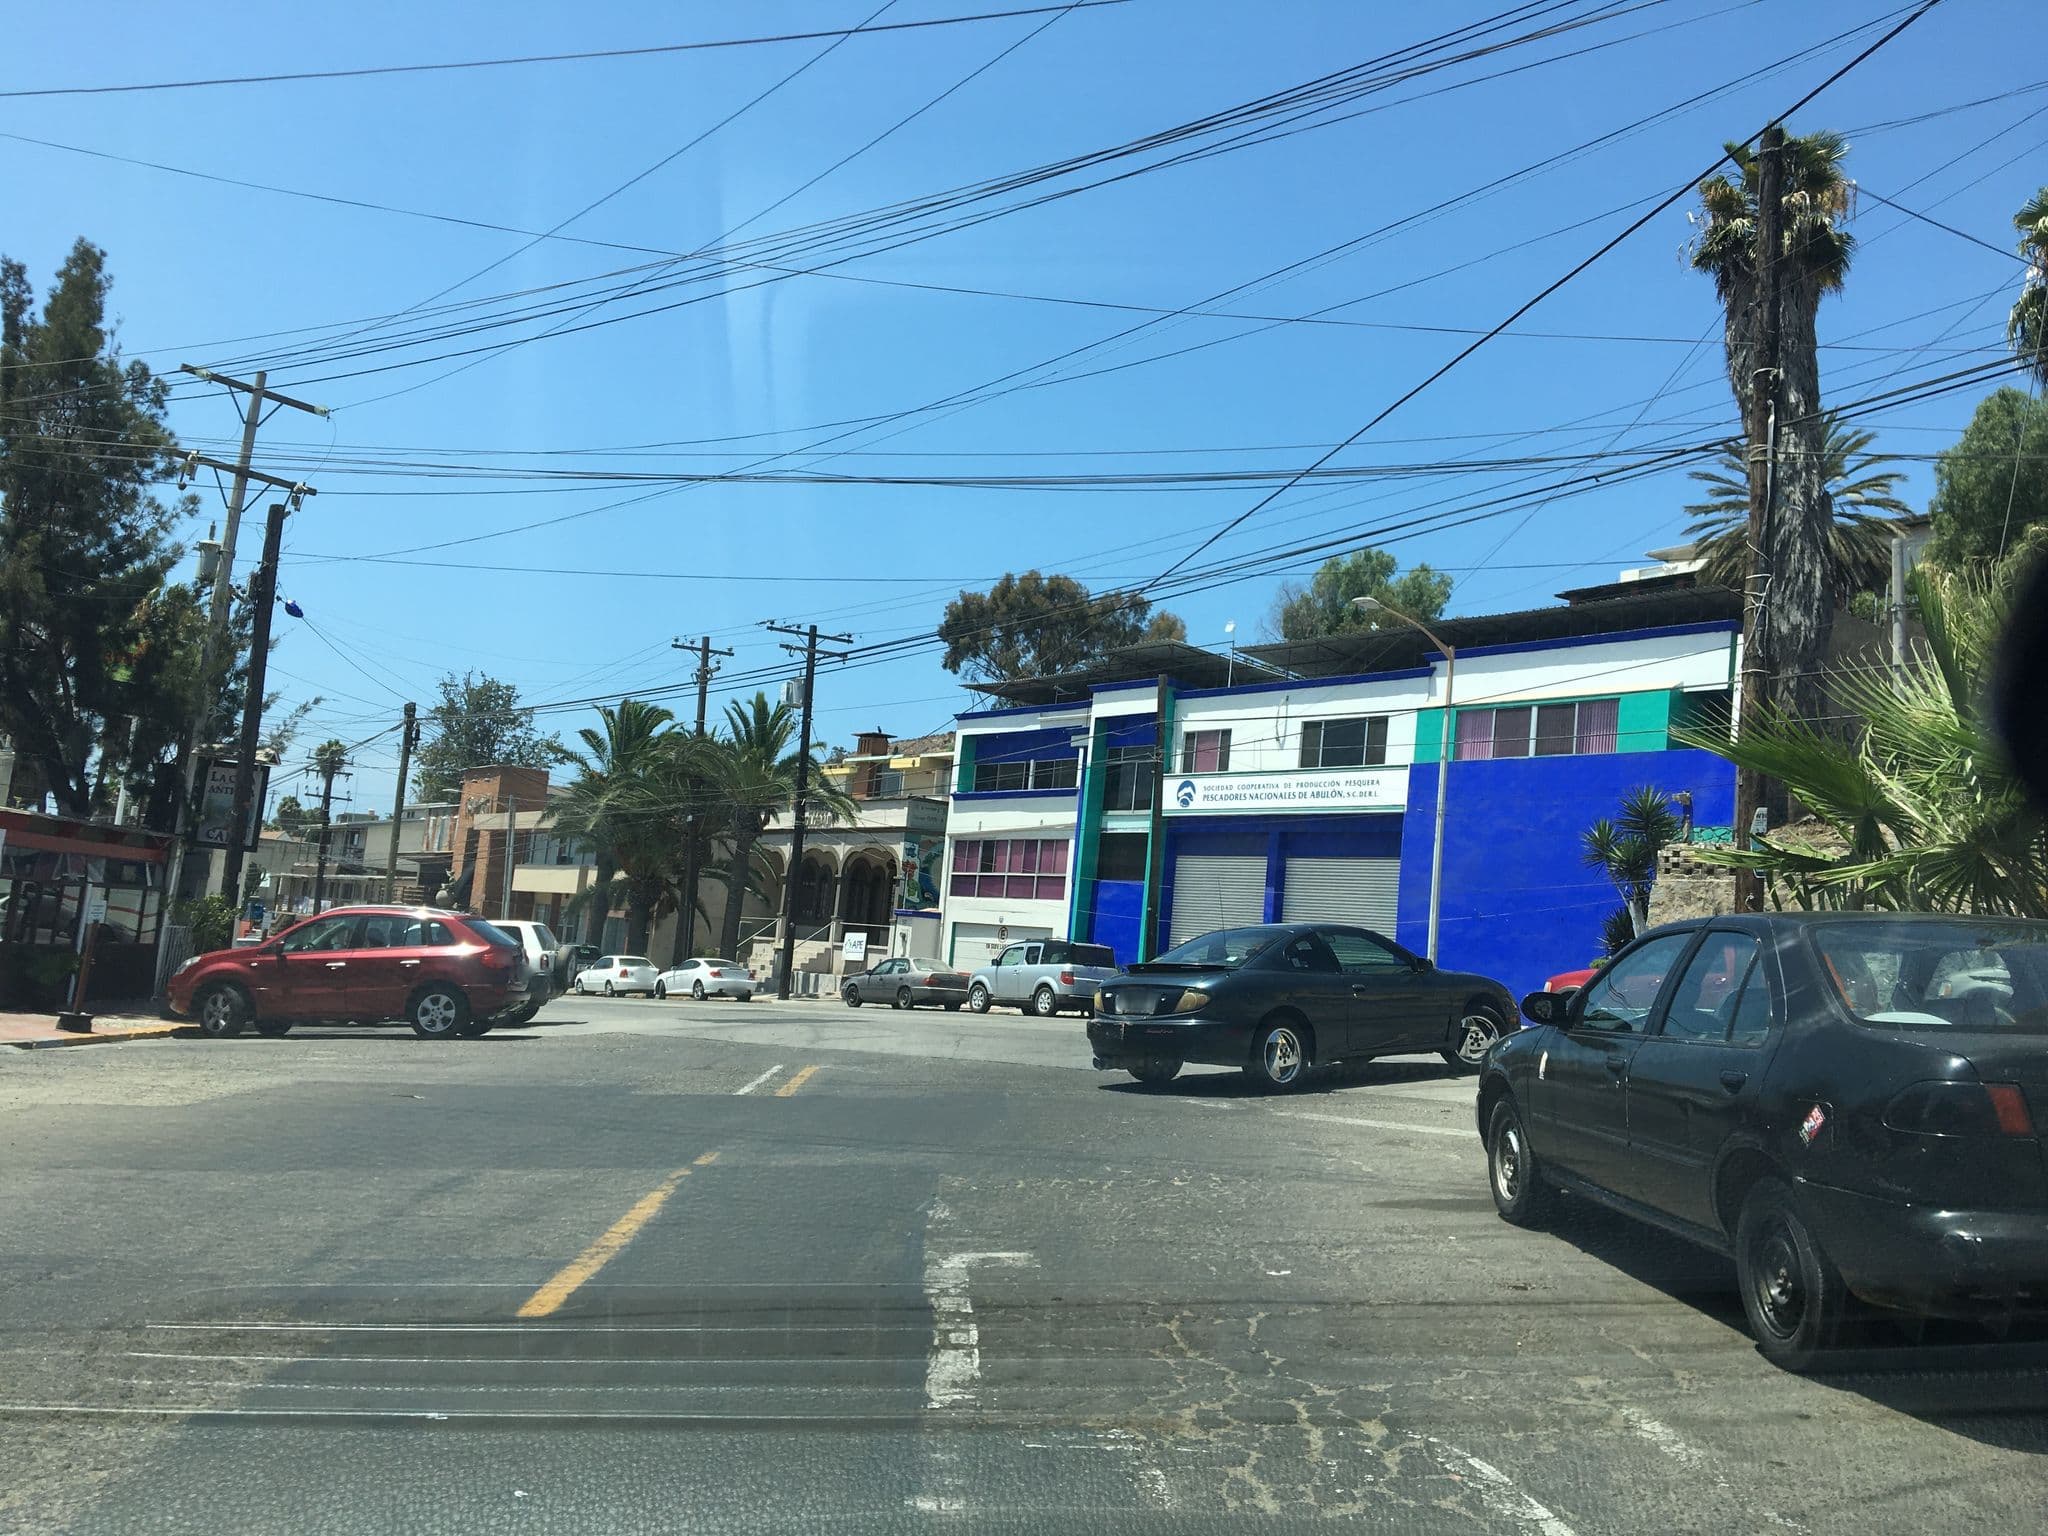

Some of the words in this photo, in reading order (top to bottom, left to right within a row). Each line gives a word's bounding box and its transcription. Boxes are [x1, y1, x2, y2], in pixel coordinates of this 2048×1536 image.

[1203, 784, 1234, 792] SOCIEDAD
[1237, 783, 1280, 791] COOPERATIVA
[1296, 780, 1341, 788] PRODUCCIÓN
[1345, 779, 1381, 787] PESQUERA
[1202, 793, 1248, 802] PESCADORES
[1248, 791, 1297, 801] NACIONALES
[1298, 791, 1308, 799] DE
